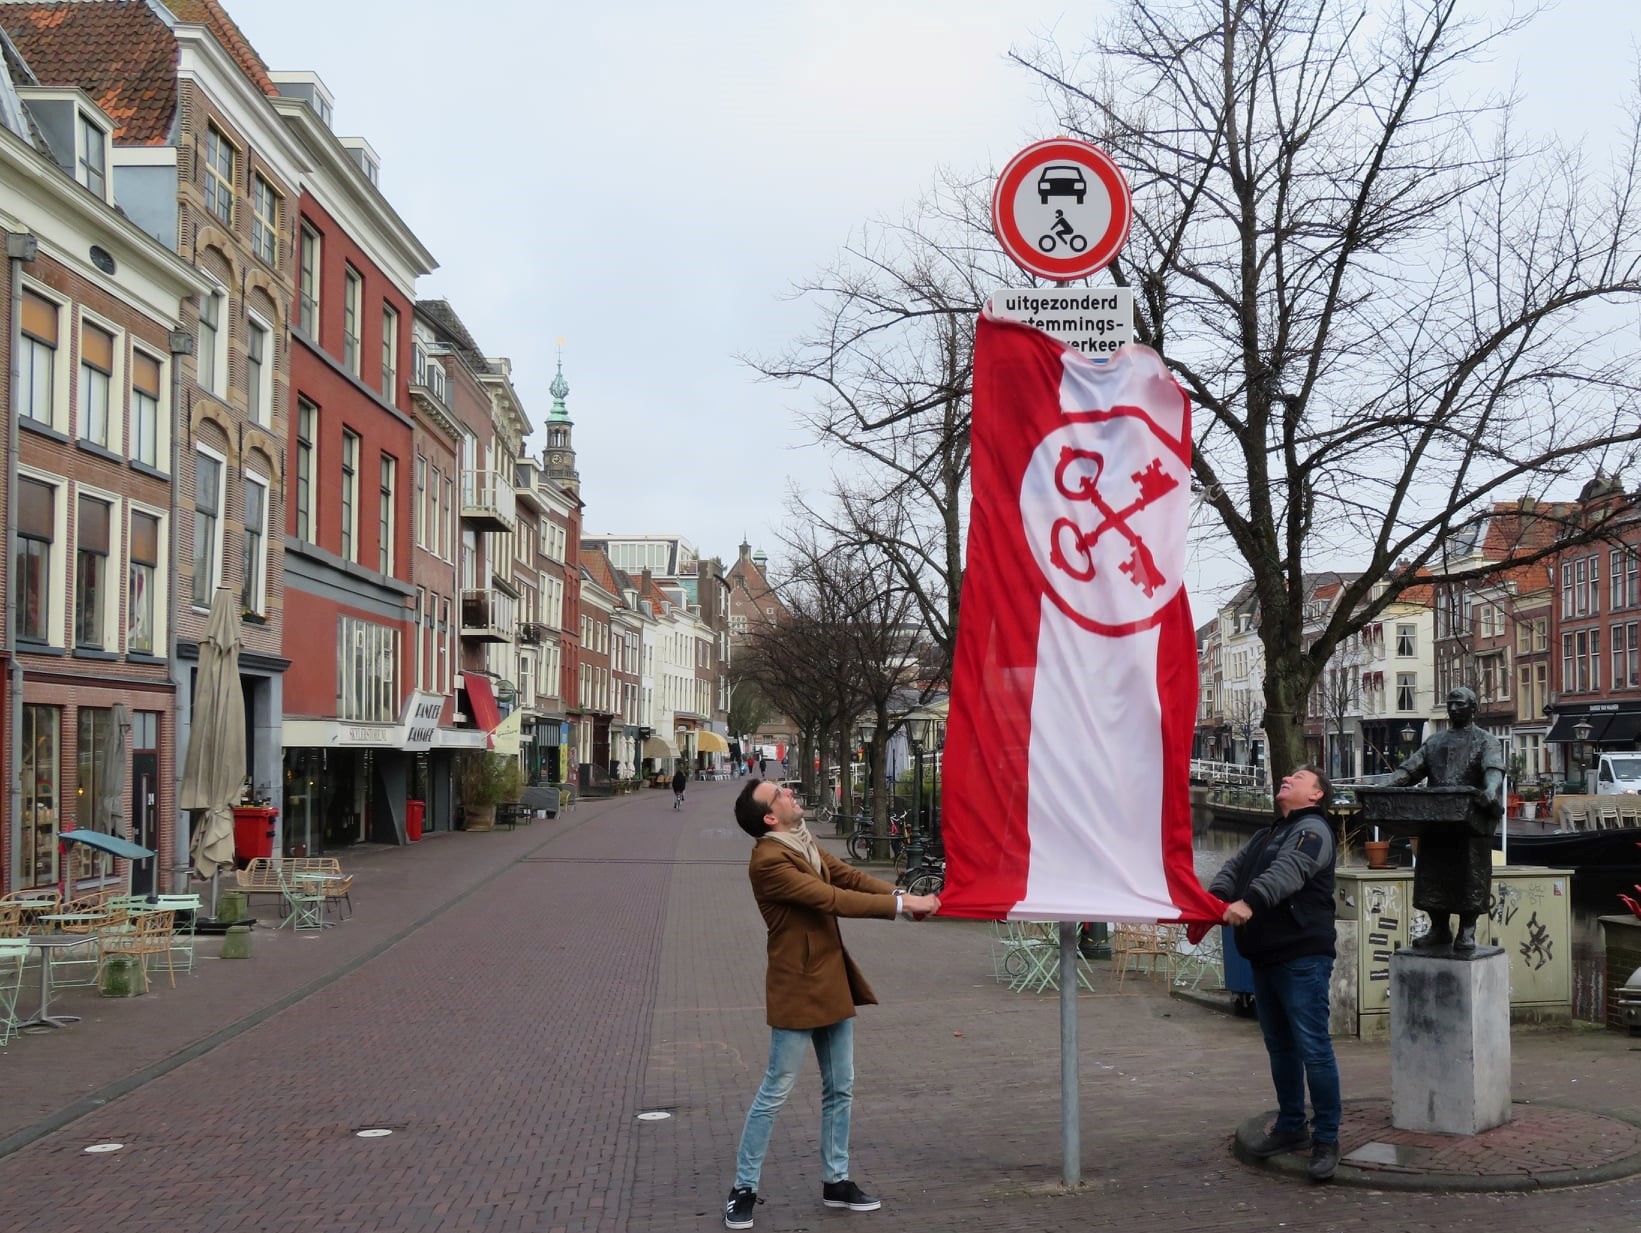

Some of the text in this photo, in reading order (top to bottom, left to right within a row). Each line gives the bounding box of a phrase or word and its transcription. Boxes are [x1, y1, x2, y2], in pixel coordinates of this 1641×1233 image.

[1006, 295, 1118, 315] uitgezonderd
[1020, 317, 1124, 336] temmings-
[1066, 337, 1126, 353] erkeer
